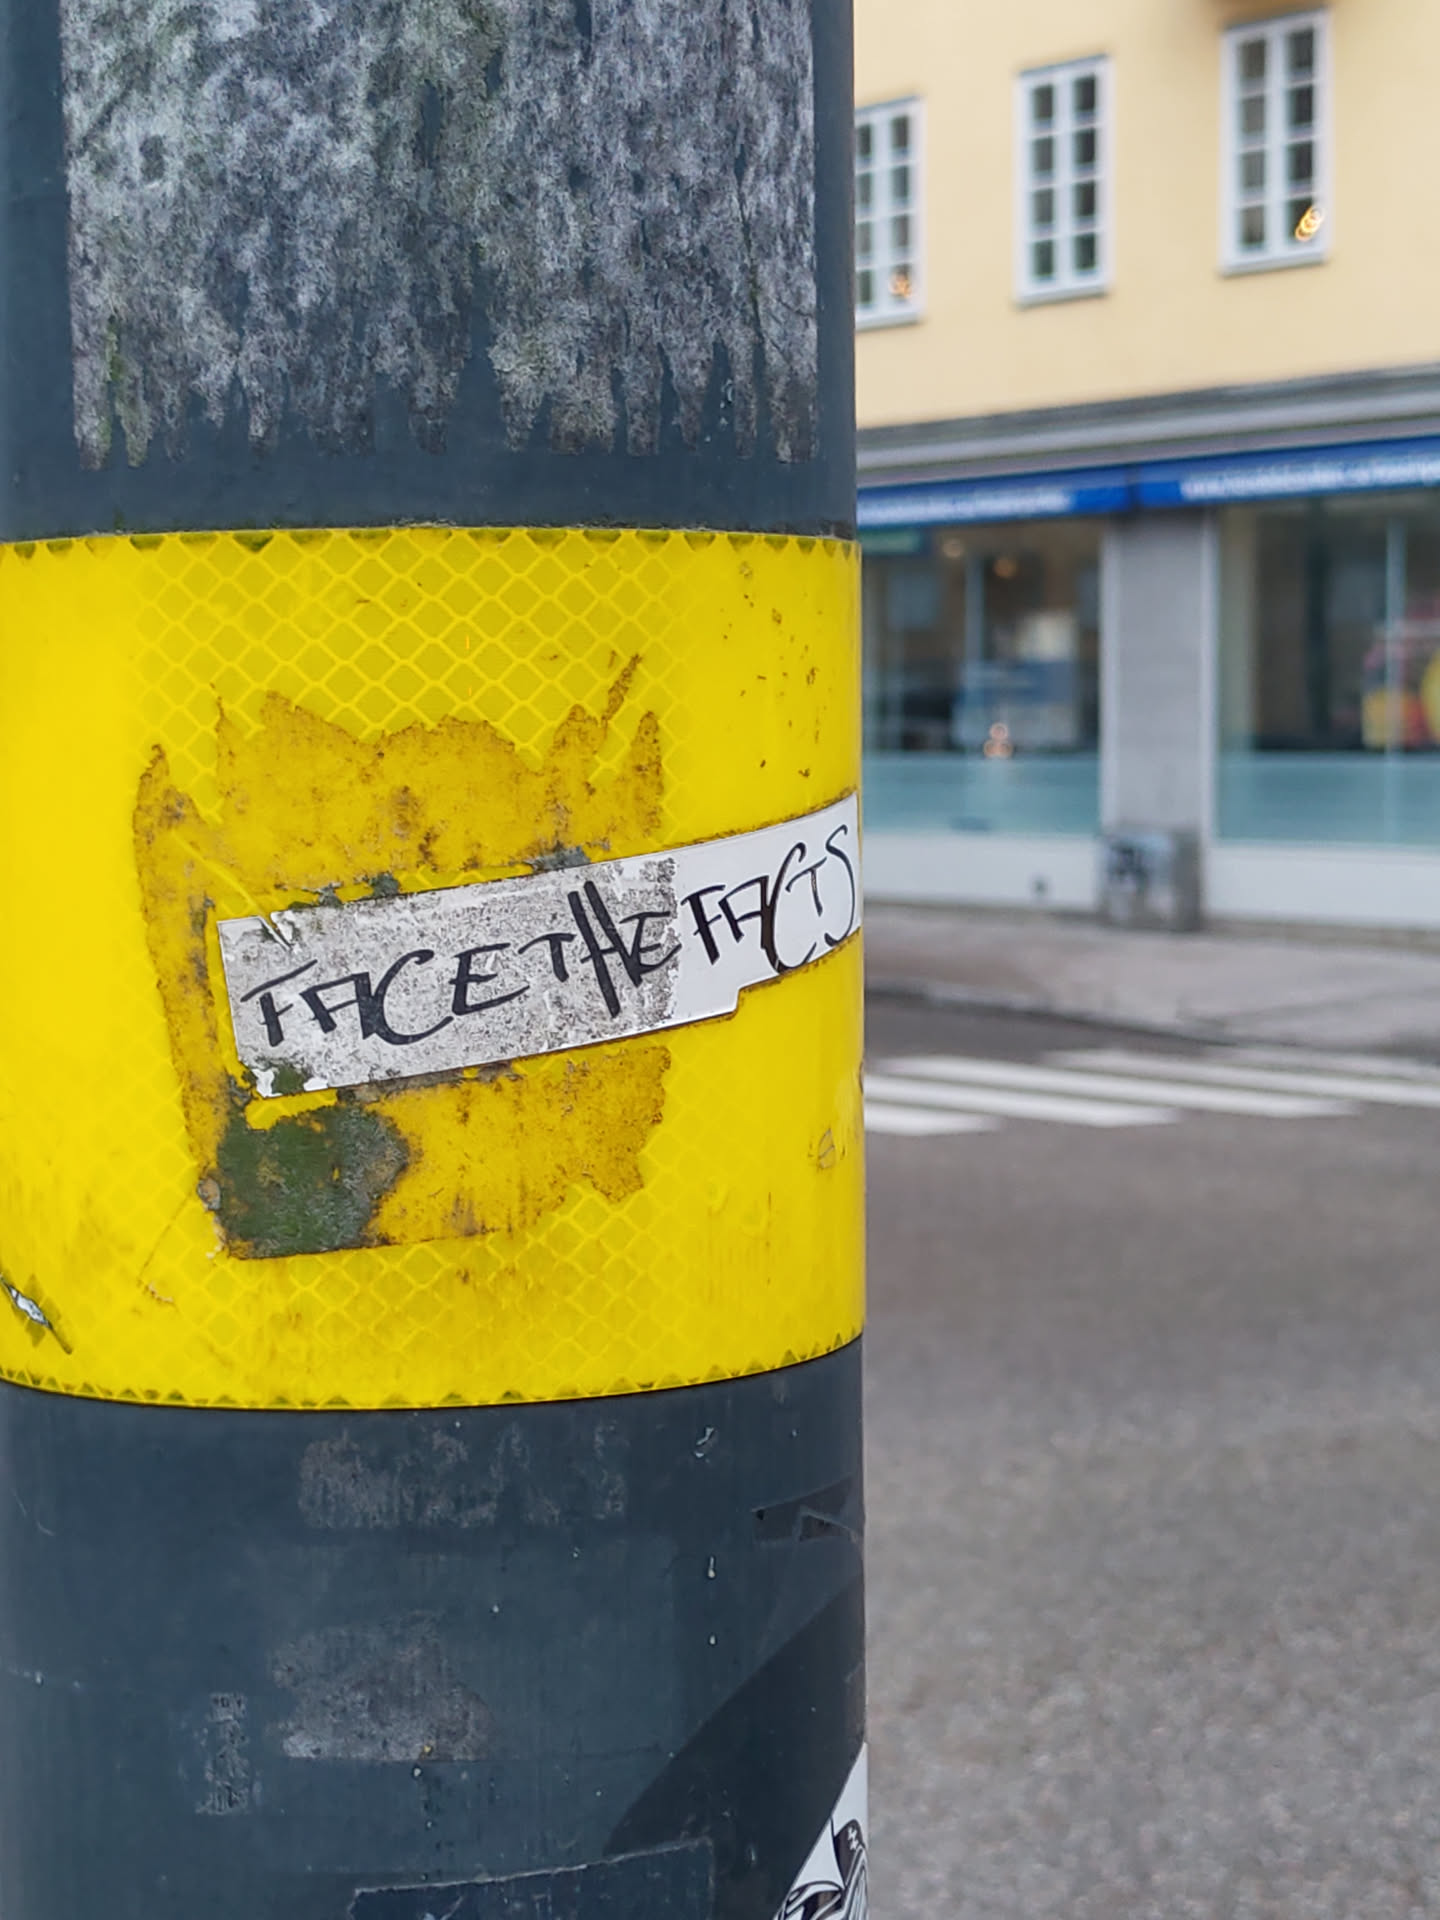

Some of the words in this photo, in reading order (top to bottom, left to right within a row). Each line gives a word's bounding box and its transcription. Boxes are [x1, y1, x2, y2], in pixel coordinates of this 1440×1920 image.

[241, 943, 529, 1045] FACE
[518, 881, 681, 1017] THE
[681, 825, 857, 973] FACTS
